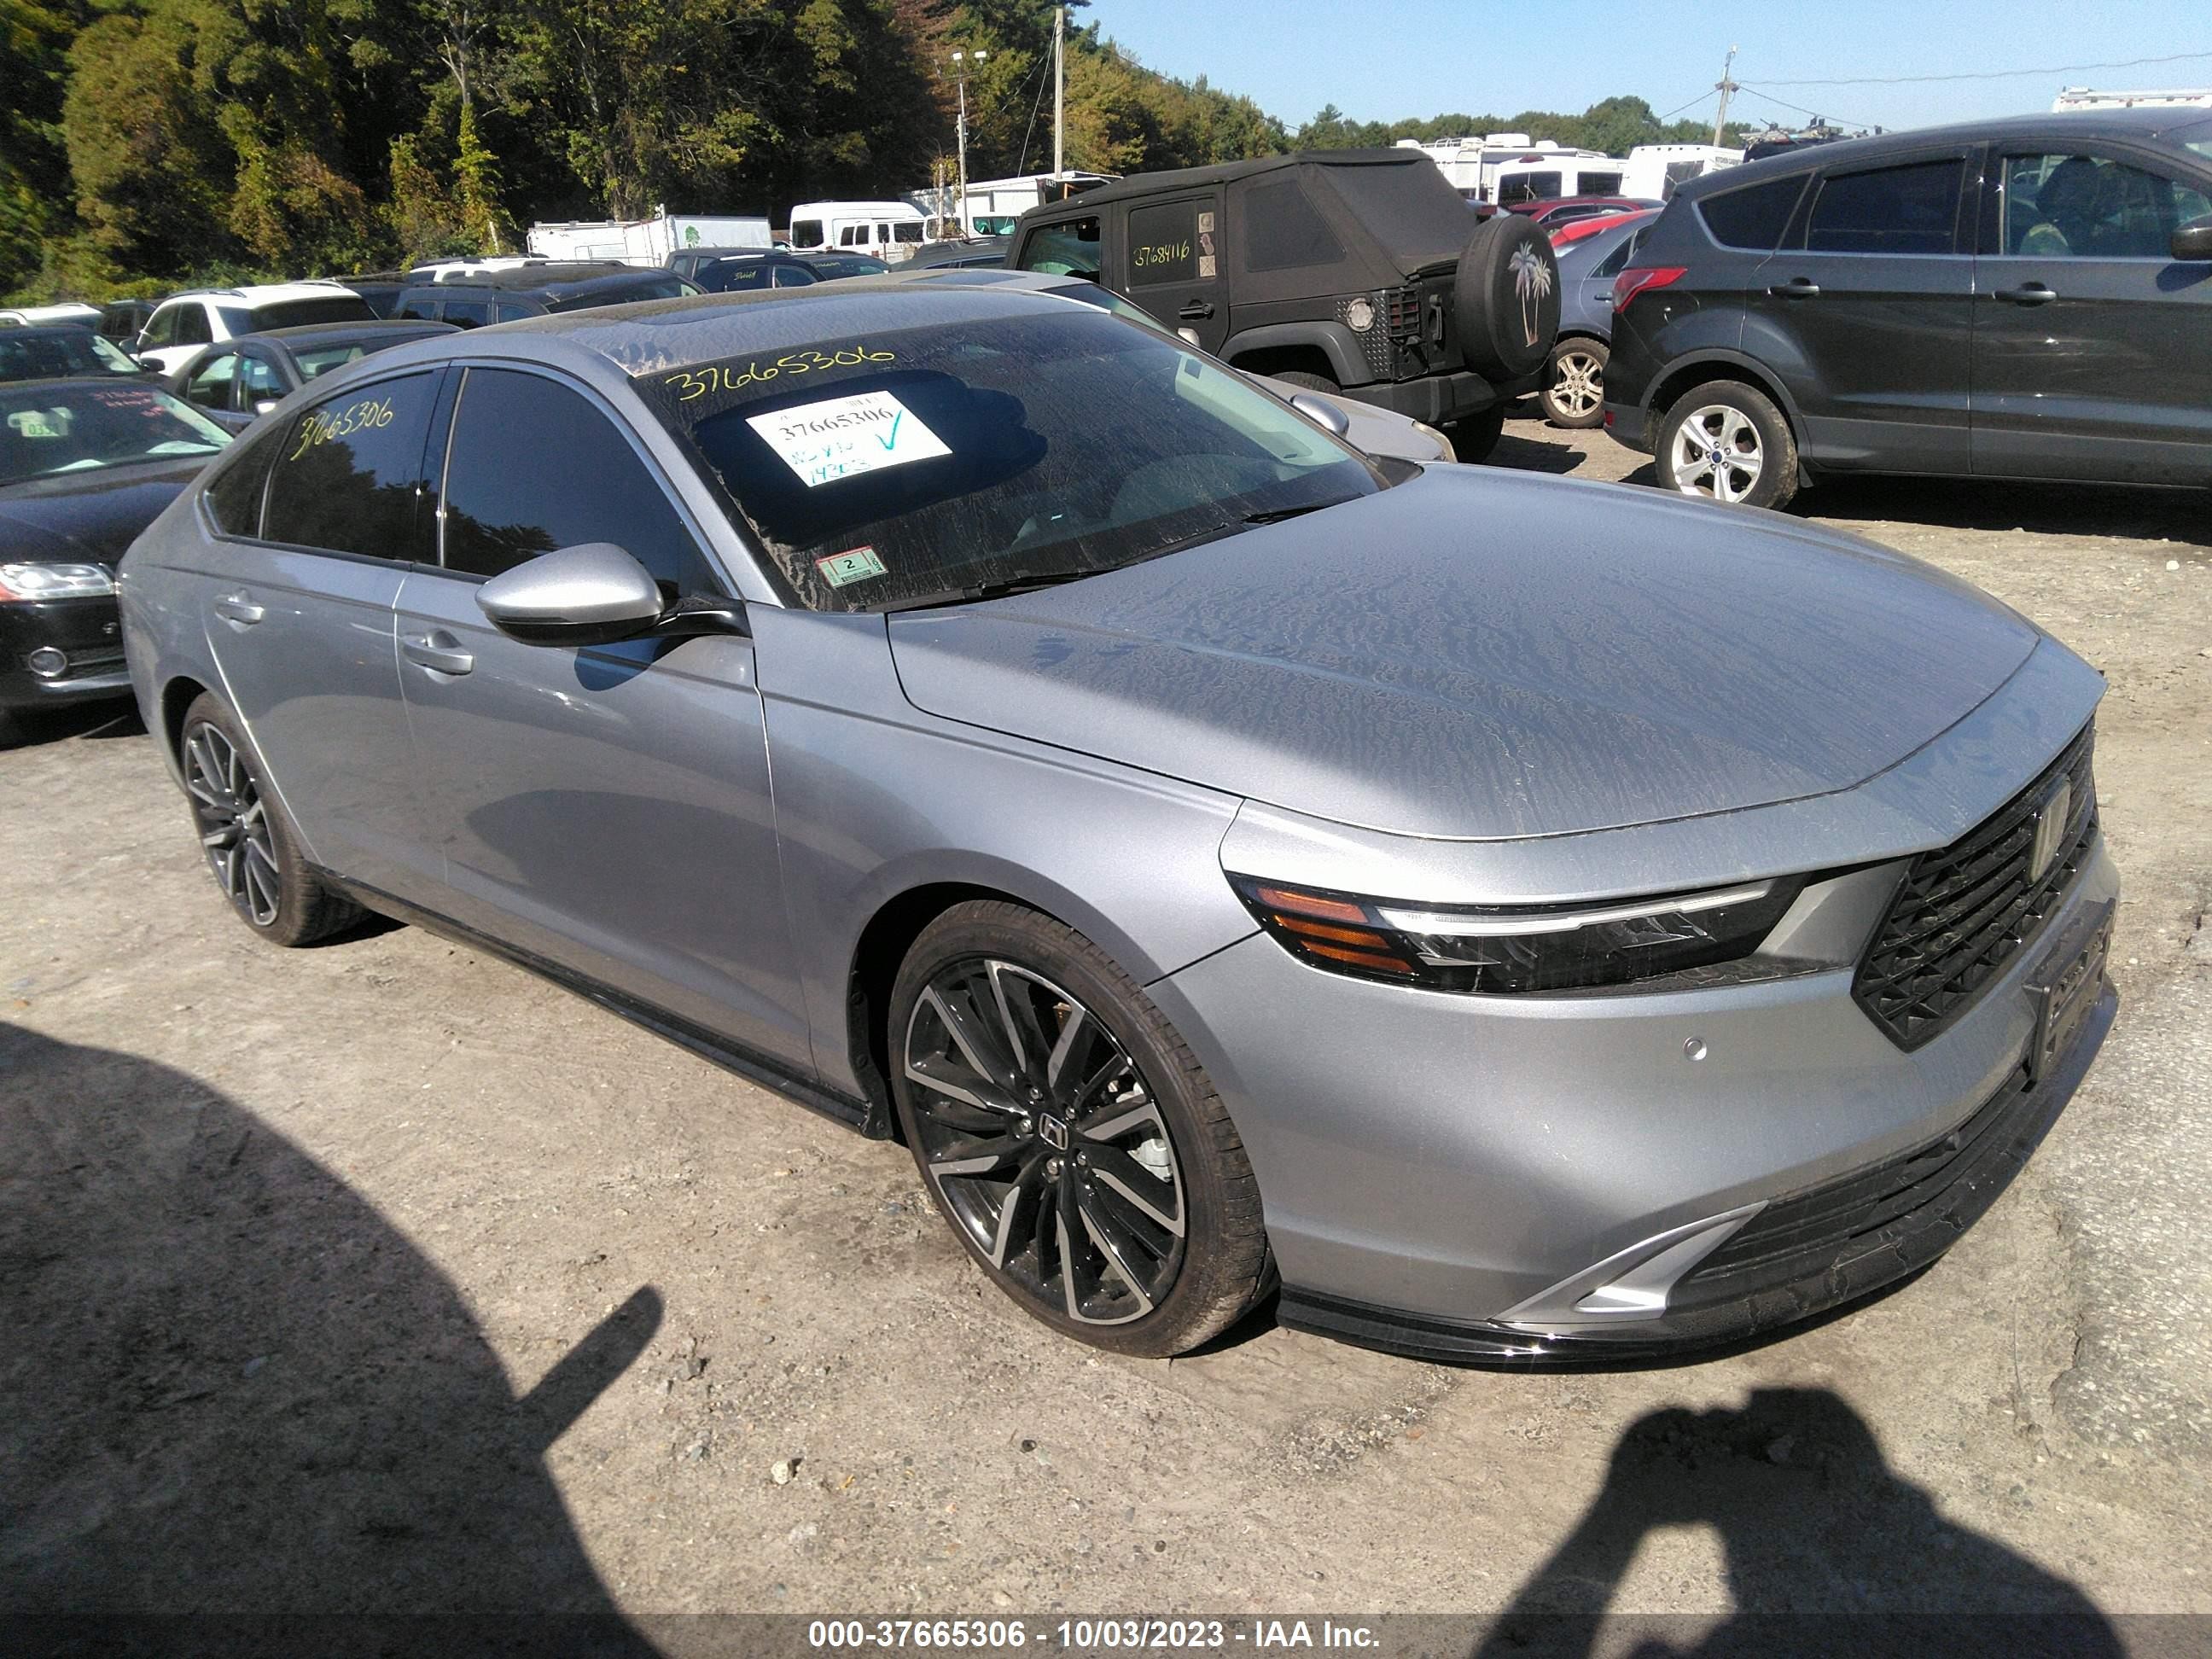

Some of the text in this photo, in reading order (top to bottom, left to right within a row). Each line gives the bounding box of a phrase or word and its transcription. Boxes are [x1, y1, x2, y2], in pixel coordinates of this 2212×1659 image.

[1133, 239, 1190, 266] 37684116
[665, 346, 895, 401] 37665306
[778, 408, 894, 440] 37665306
[843, 559, 856, 569] 2
